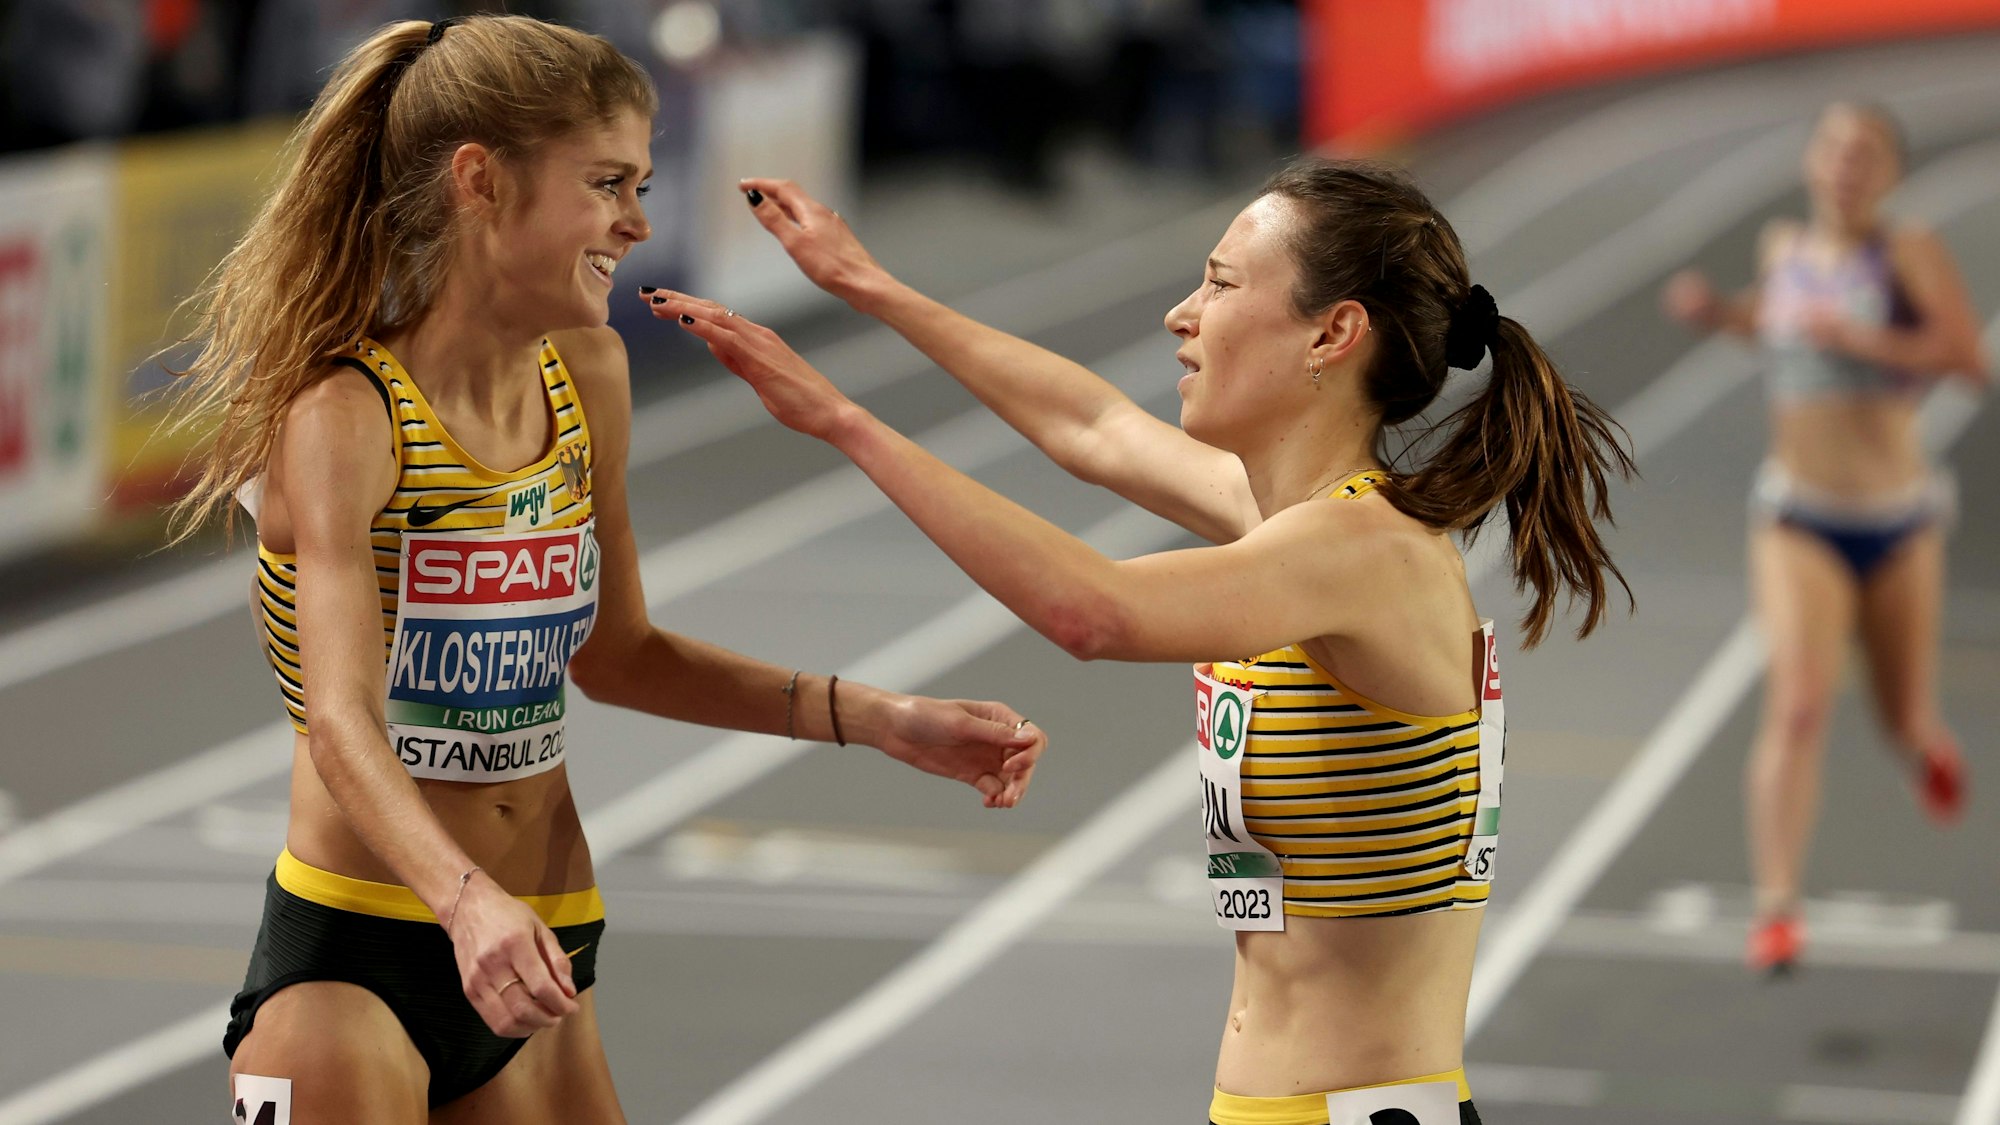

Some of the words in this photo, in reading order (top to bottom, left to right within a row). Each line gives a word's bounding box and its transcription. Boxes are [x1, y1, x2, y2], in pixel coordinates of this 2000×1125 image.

[414, 544, 576, 595] SPAR
[442, 709, 451, 725] I
[457, 709, 507, 731] RUN
[512, 700, 560, 727] CLEAN
[396, 735, 535, 772] ISTANBUL
[1220, 889, 1271, 919] 2023
